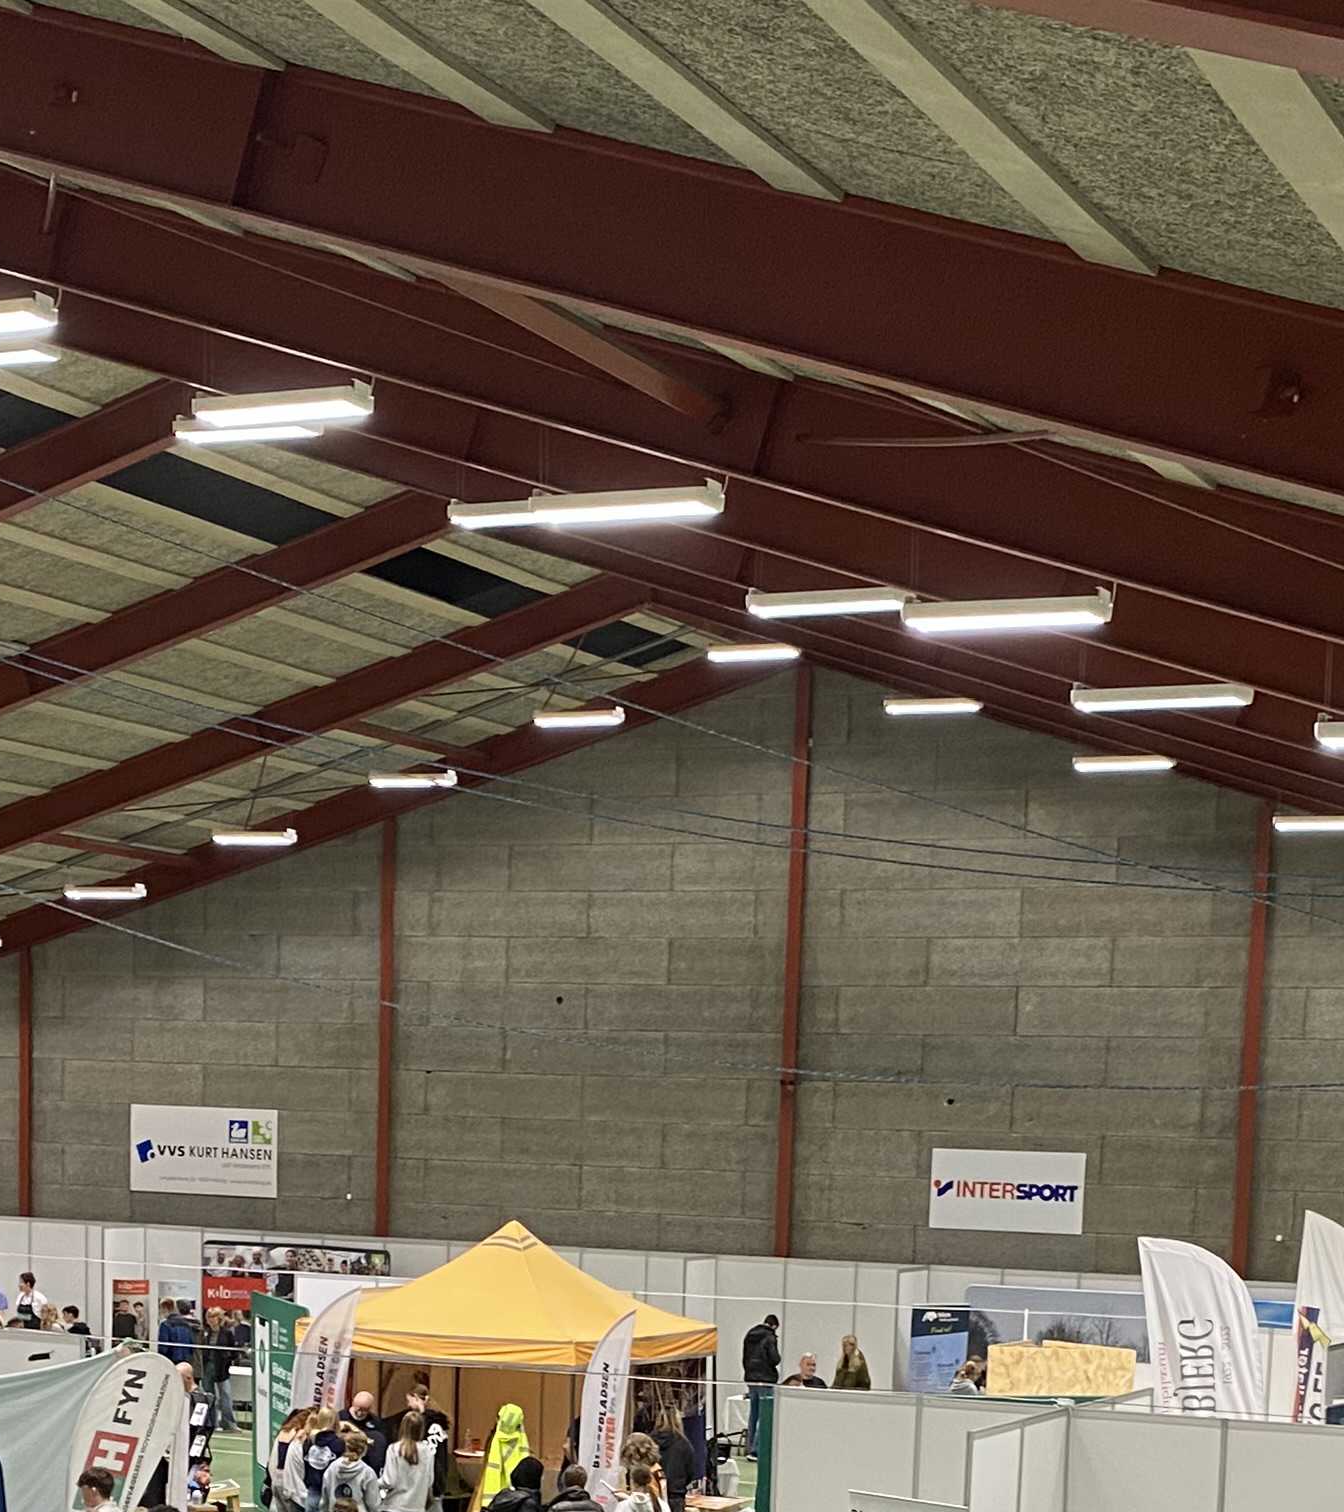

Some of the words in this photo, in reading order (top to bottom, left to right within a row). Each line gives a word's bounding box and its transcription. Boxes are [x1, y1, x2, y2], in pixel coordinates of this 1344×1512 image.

[157, 1144, 185, 1157] VVS
[189, 1146, 218, 1158] KURT
[221, 1147, 272, 1161] HANSEN
[956, 1180, 1078, 1202] INTERSPORT
[312, 1335, 329, 1409] EPLADSEN
[112, 1368, 147, 1426] FYN
